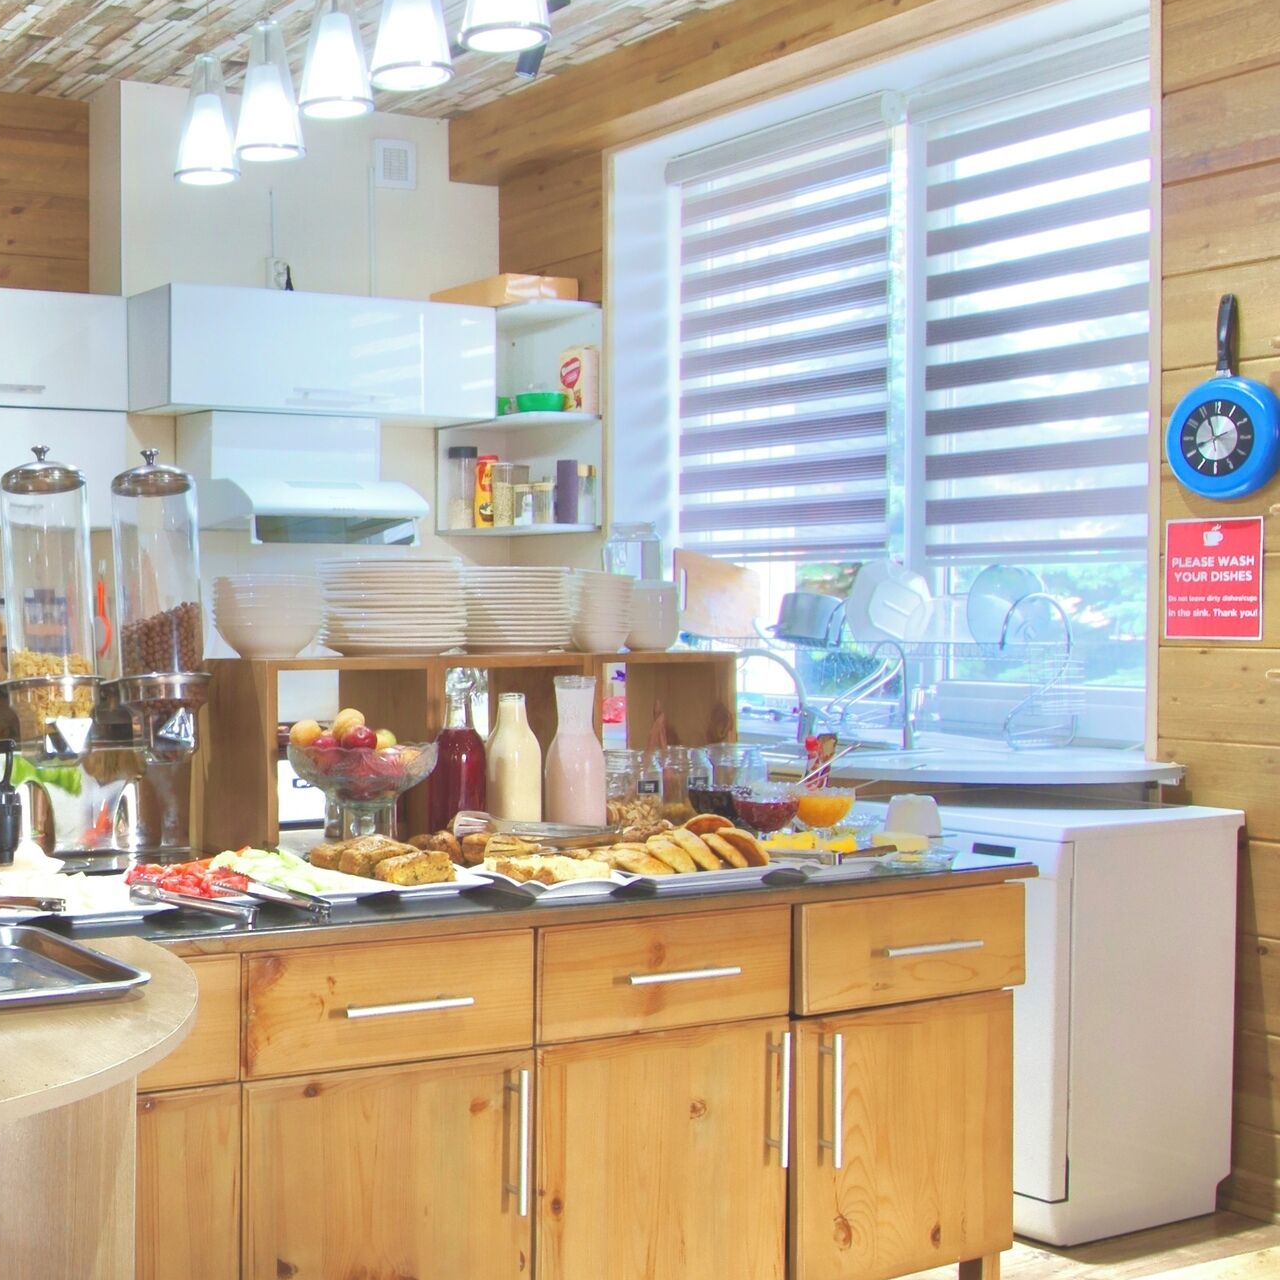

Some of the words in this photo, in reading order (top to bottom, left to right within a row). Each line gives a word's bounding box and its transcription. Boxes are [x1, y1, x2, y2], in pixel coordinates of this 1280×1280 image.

[1172, 556, 1215, 568] PLEASE
[1217, 555, 1255, 567] WASH
[1174, 571, 1208, 582] YOUR
[1210, 570, 1253, 582] DISHES
[1177, 608, 1191, 617] the
[1193, 608, 1211, 617] sink.
[1212, 608, 1237, 617] Thank
[1239, 608, 1258, 619] you!
